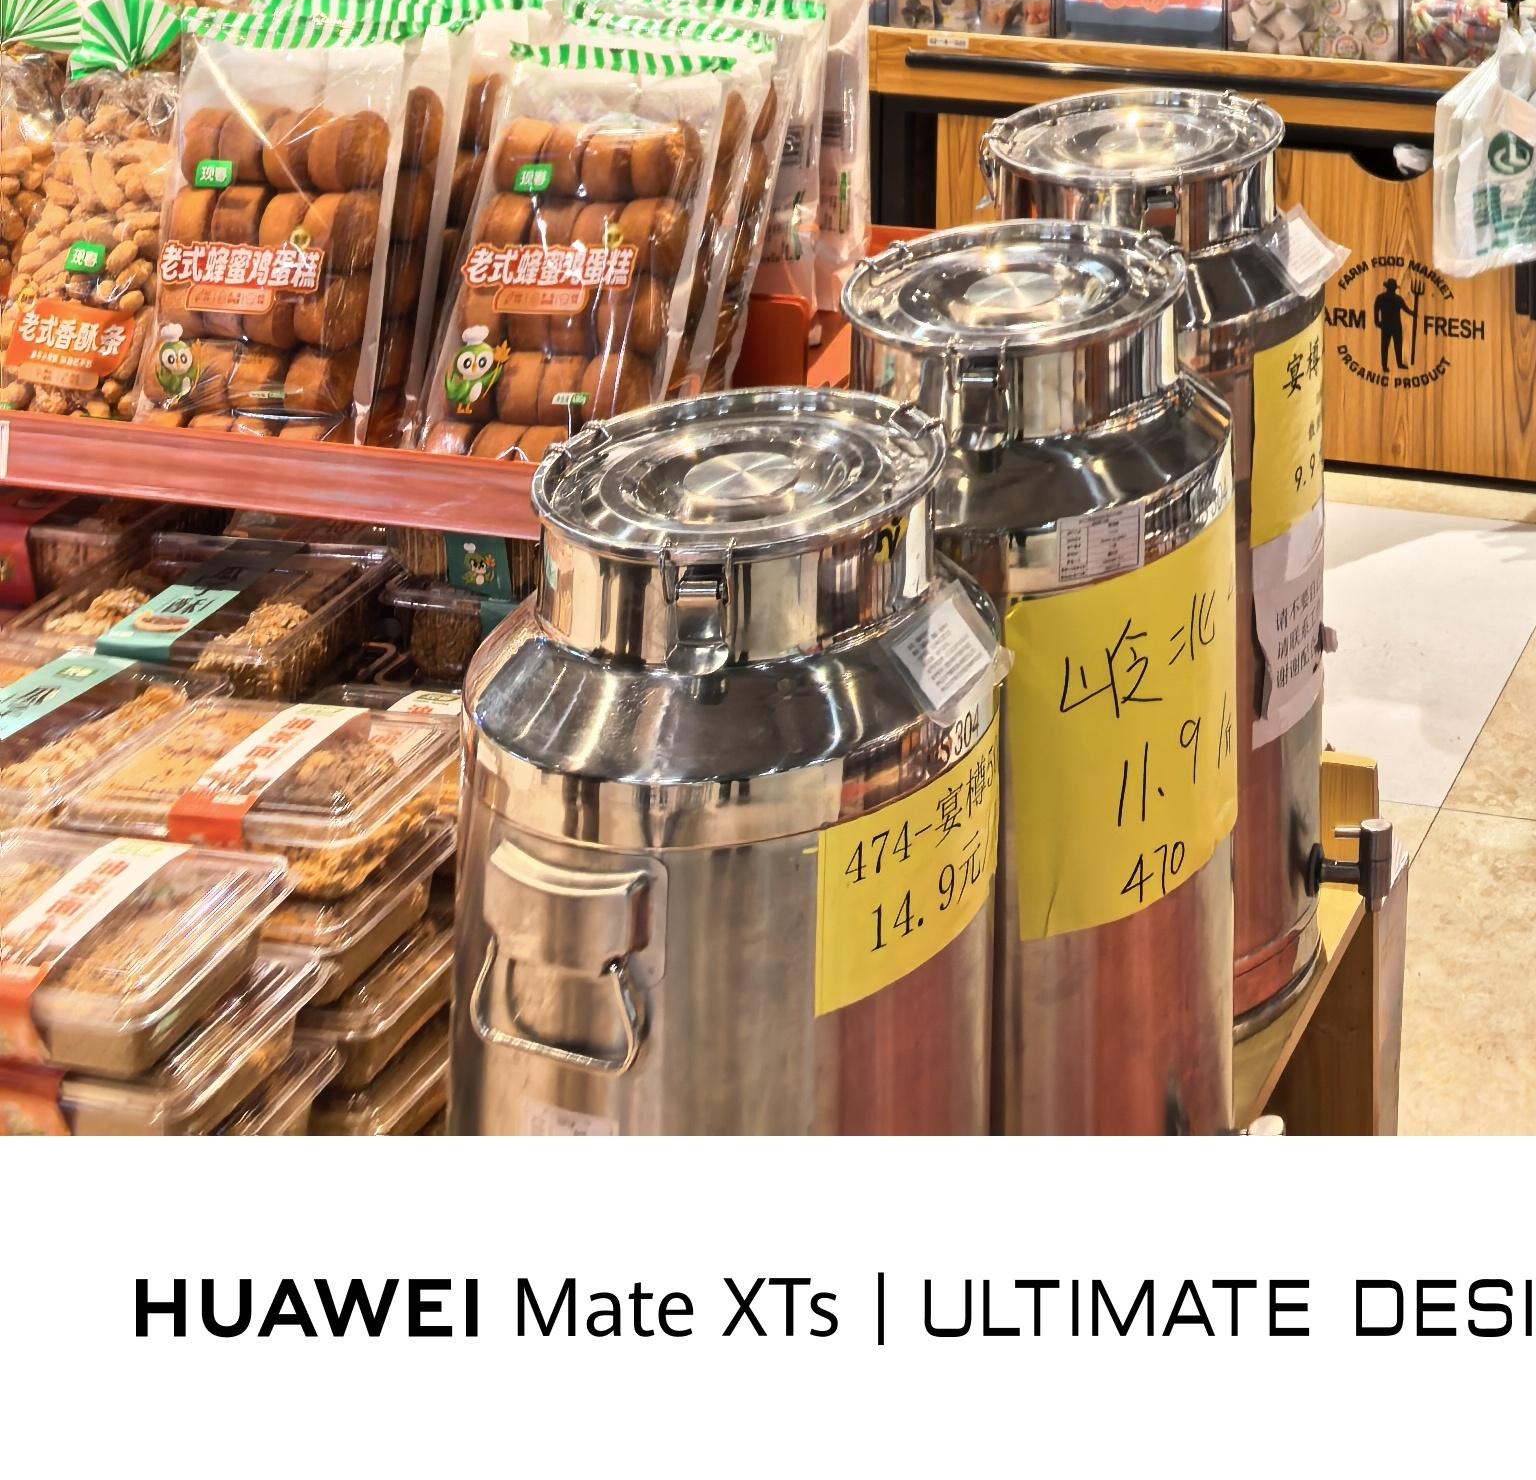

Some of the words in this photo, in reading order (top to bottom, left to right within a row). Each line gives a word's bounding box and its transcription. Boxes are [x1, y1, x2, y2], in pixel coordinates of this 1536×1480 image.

[161, 244, 320, 289] 老式蜂蜜鸡蛋糕
[467, 246, 634, 287] 老式蜂蜜鸡蛋糕
[1338, 261, 1369, 290] FARM
[1371, 256, 1405, 268] FOOD
[1408, 260, 1454, 301] MARKET
[19, 311, 126, 357] 老式香酥条
[1324, 306, 1366, 330] ARM
[1424, 315, 1485, 341] FRESH
[1337, 344, 1389, 388] ORGANIC
[1394, 356, 1452, 389] PRODUCT
[1121, 840, 1185, 903] 470
